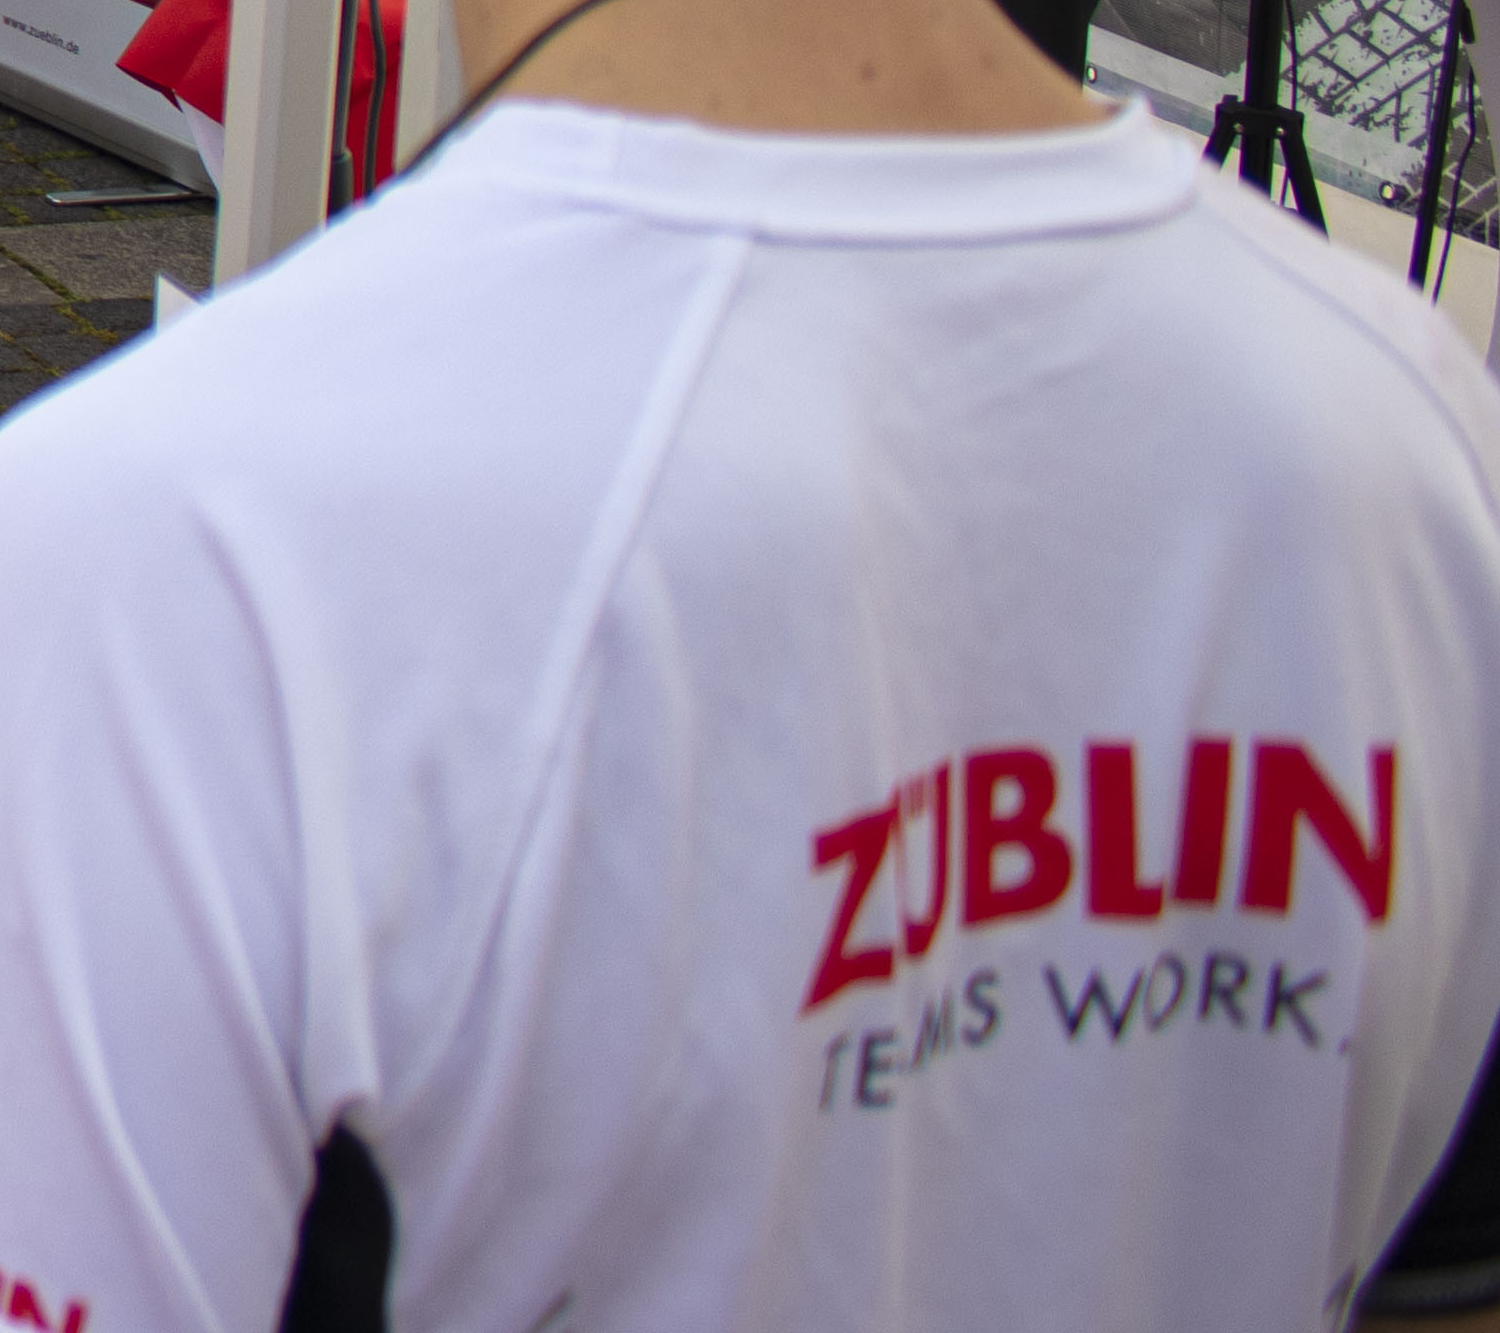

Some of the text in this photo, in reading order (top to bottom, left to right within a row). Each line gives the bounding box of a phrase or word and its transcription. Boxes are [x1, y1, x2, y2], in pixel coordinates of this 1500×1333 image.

[2, 15, 81, 54] www.zueblin.de
[798, 733, 1398, 1021] ZÜBLIN
[819, 968, 1001, 1113] TEMS
